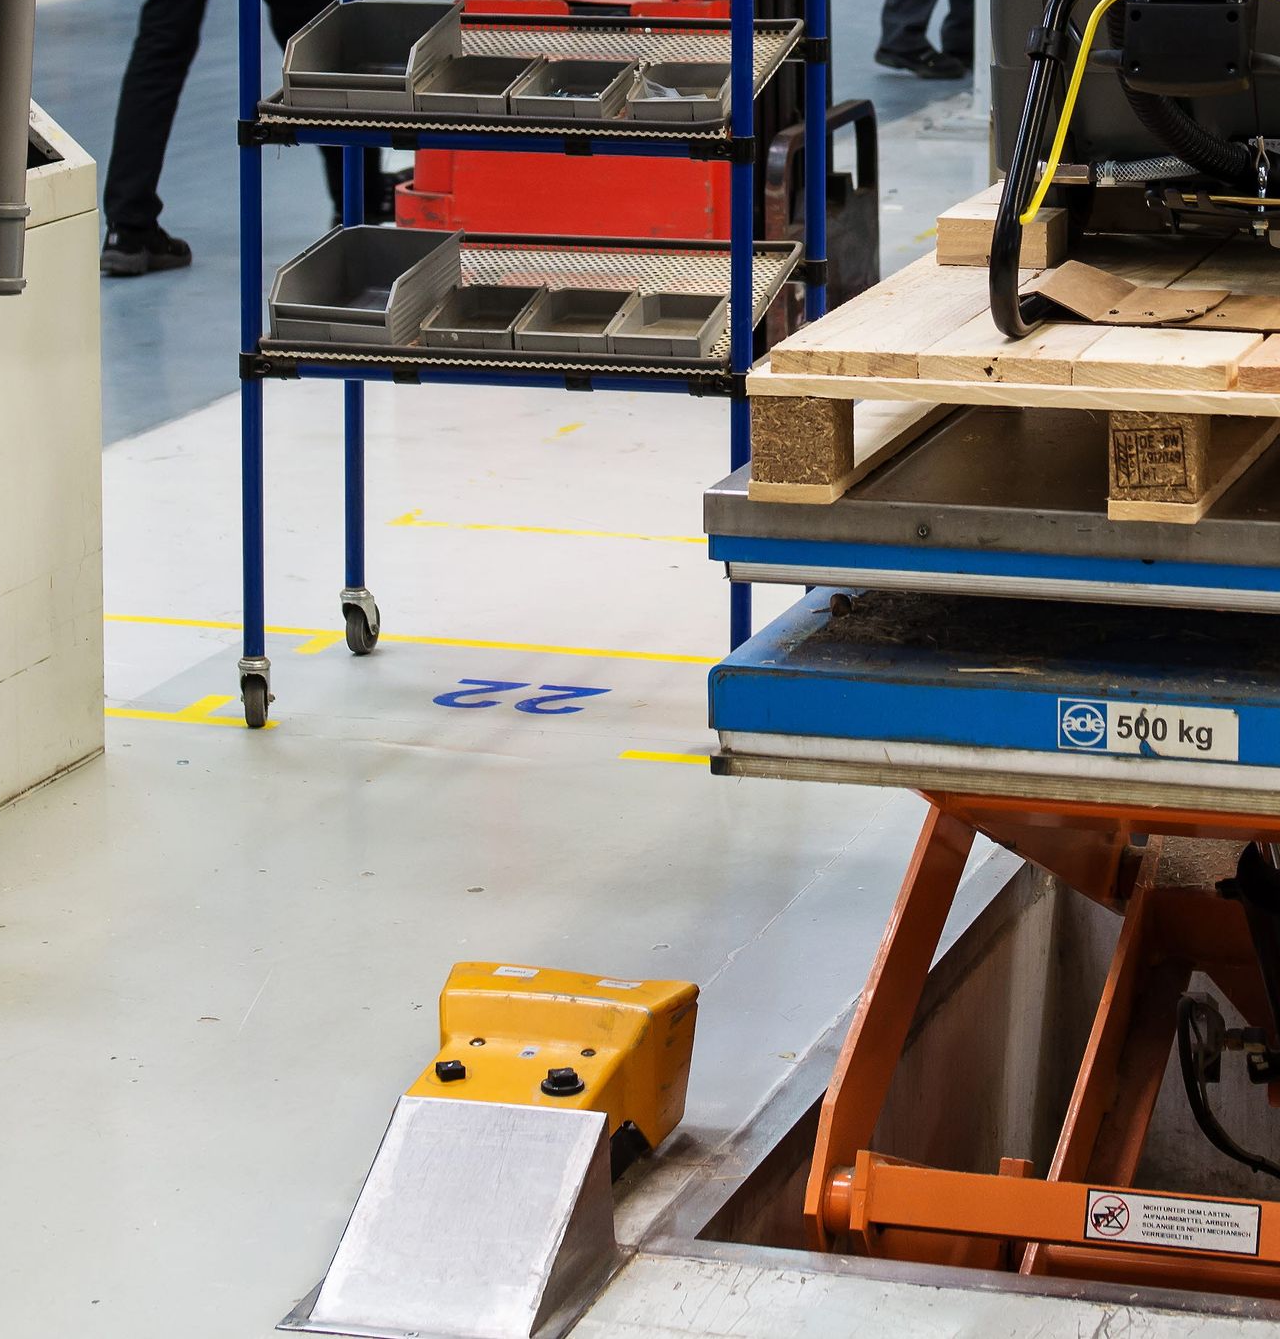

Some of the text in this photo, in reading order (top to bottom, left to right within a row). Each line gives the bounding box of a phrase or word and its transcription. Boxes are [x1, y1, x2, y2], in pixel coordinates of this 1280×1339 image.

[432, 678, 613, 715] 22
[1062, 712, 1213, 751] ade 500 kg
[1142, 1204, 1162, 1212] NICHT
[1141, 1230, 1181, 1240] VERRIEGELT
[1142, 1222, 1174, 1230] SOLANGE
[1186, 1226, 1206, 1234] NICHT
[1207, 1228, 1251, 1238] MECHANISCH
